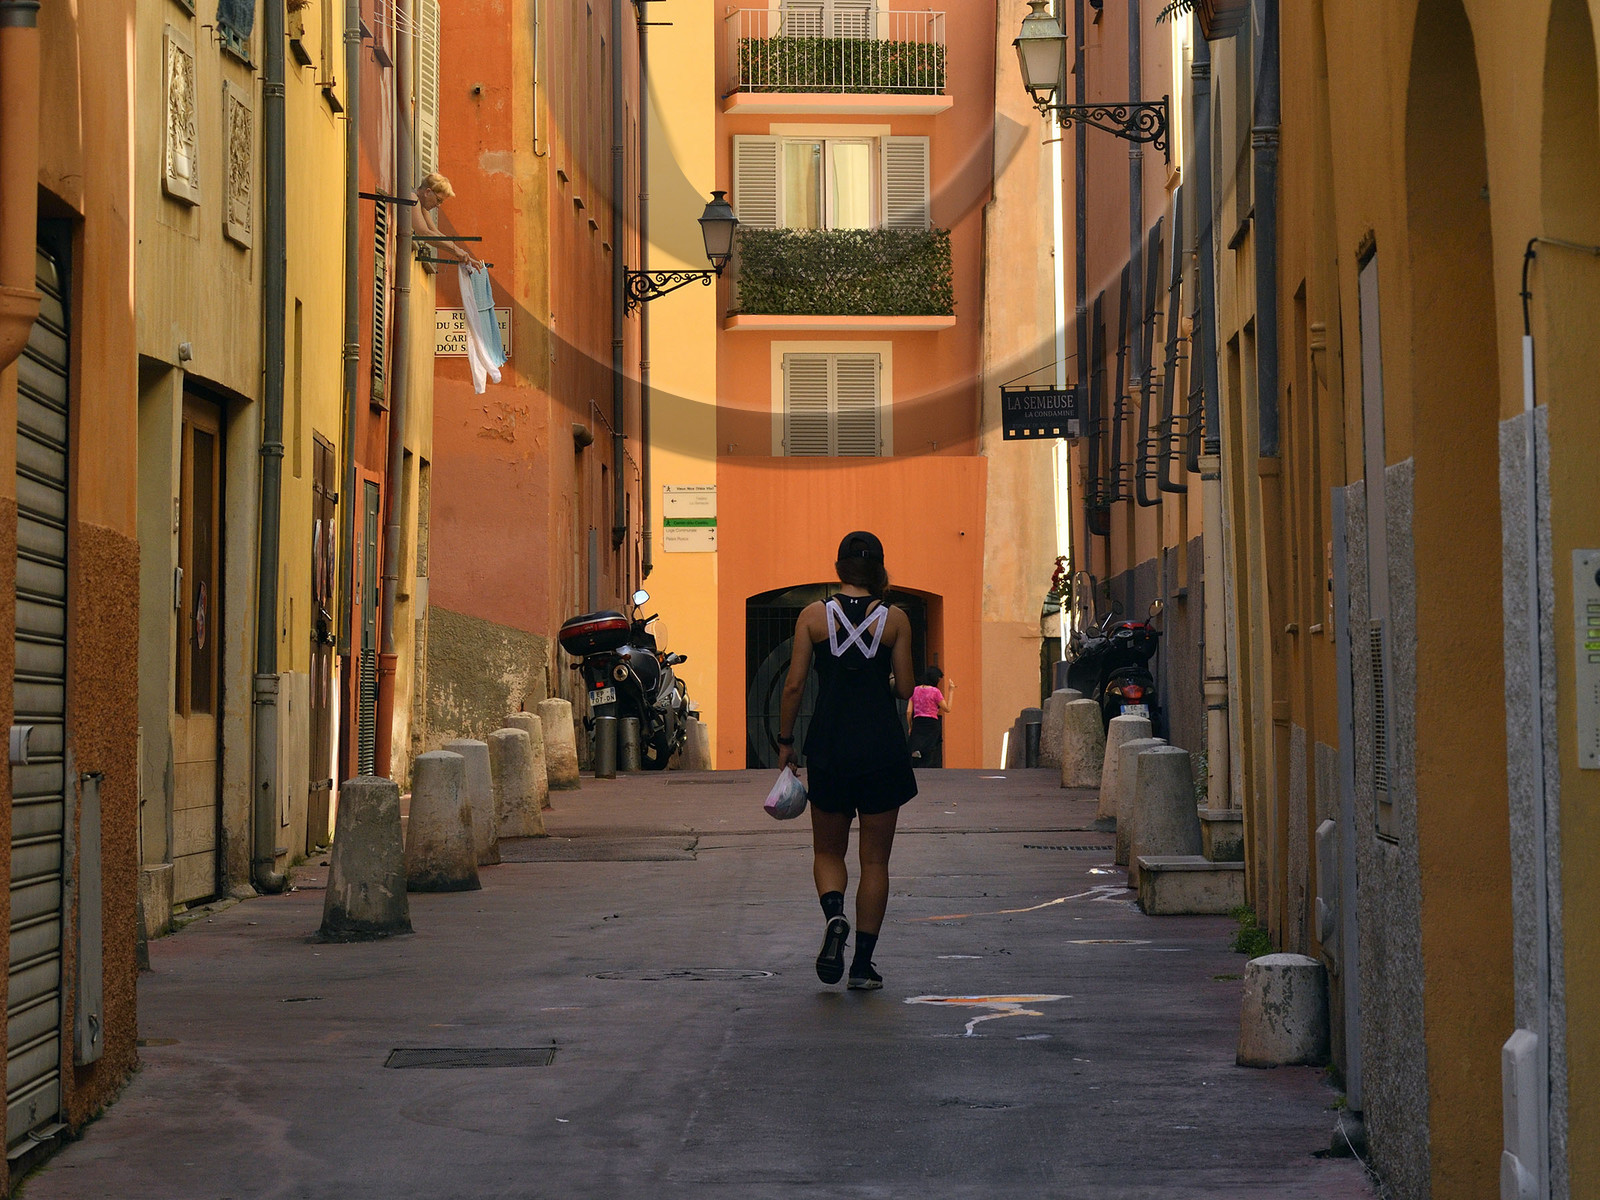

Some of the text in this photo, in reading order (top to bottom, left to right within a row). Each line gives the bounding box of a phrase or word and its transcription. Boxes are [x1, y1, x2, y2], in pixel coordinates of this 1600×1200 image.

[436, 322, 450, 330] DU
[1008, 394, 1074, 410] LA SEMEUSE
